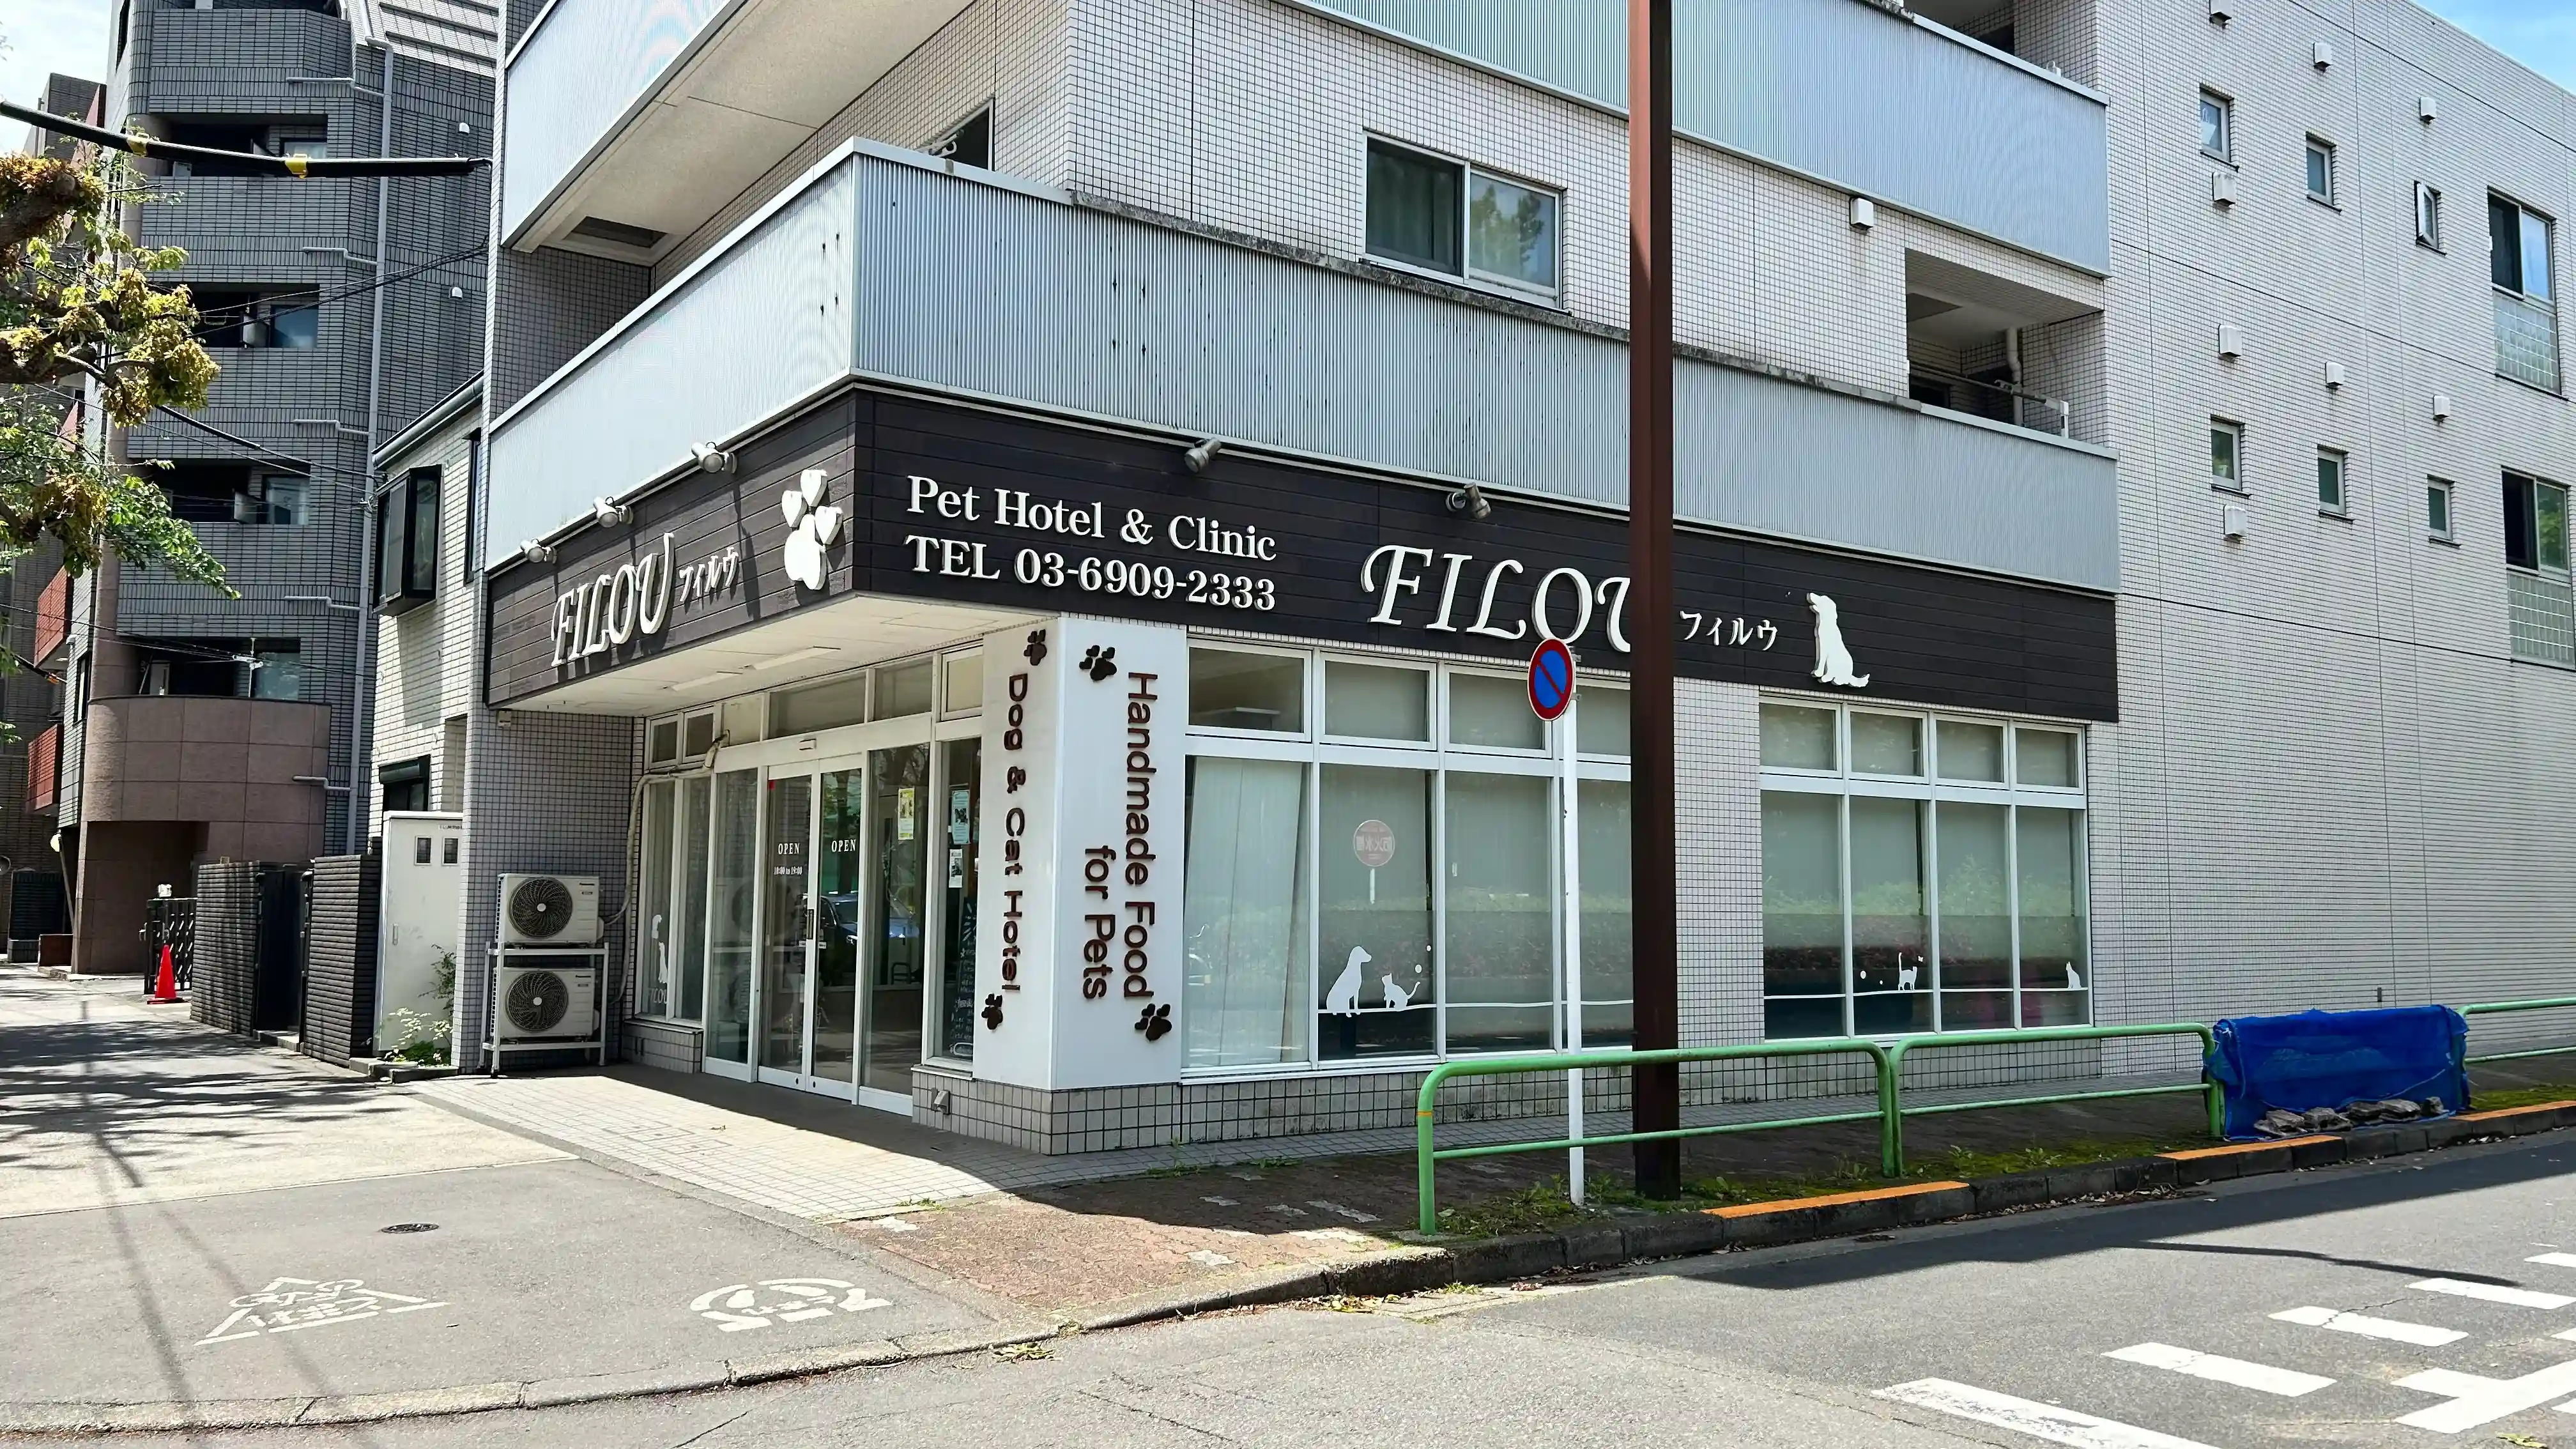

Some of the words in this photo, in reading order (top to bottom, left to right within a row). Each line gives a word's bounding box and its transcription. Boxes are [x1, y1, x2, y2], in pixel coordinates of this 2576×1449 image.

[907, 475, 980, 521] Pet
[994, 488, 1105, 539] Hotel
[1119, 509, 1154, 545] &
[1168, 515, 1276, 562] Clinic
[550, 532, 675, 667] FILOU
[679, 546, 739, 602] フィルウ
[904, 535, 1000, 580] TEL
[1014, 548, 1276, 611] 03-6909-2333
[1680, 611, 1778, 652] フィルウ
[1004, 673, 1028, 750] Dog
[1007, 766, 1026, 794] &
[1124, 672, 1158, 885] Handmade
[778, 843, 801, 855] OPEN
[831, 839, 857, 852] OPEN
[1004, 808, 1025, 876] Cat
[1084, 845, 1117, 900] for
[1001, 890, 1023, 991] Hotel
[1082, 914, 1116, 999] Pets
[1124, 901, 1156, 998] Food
